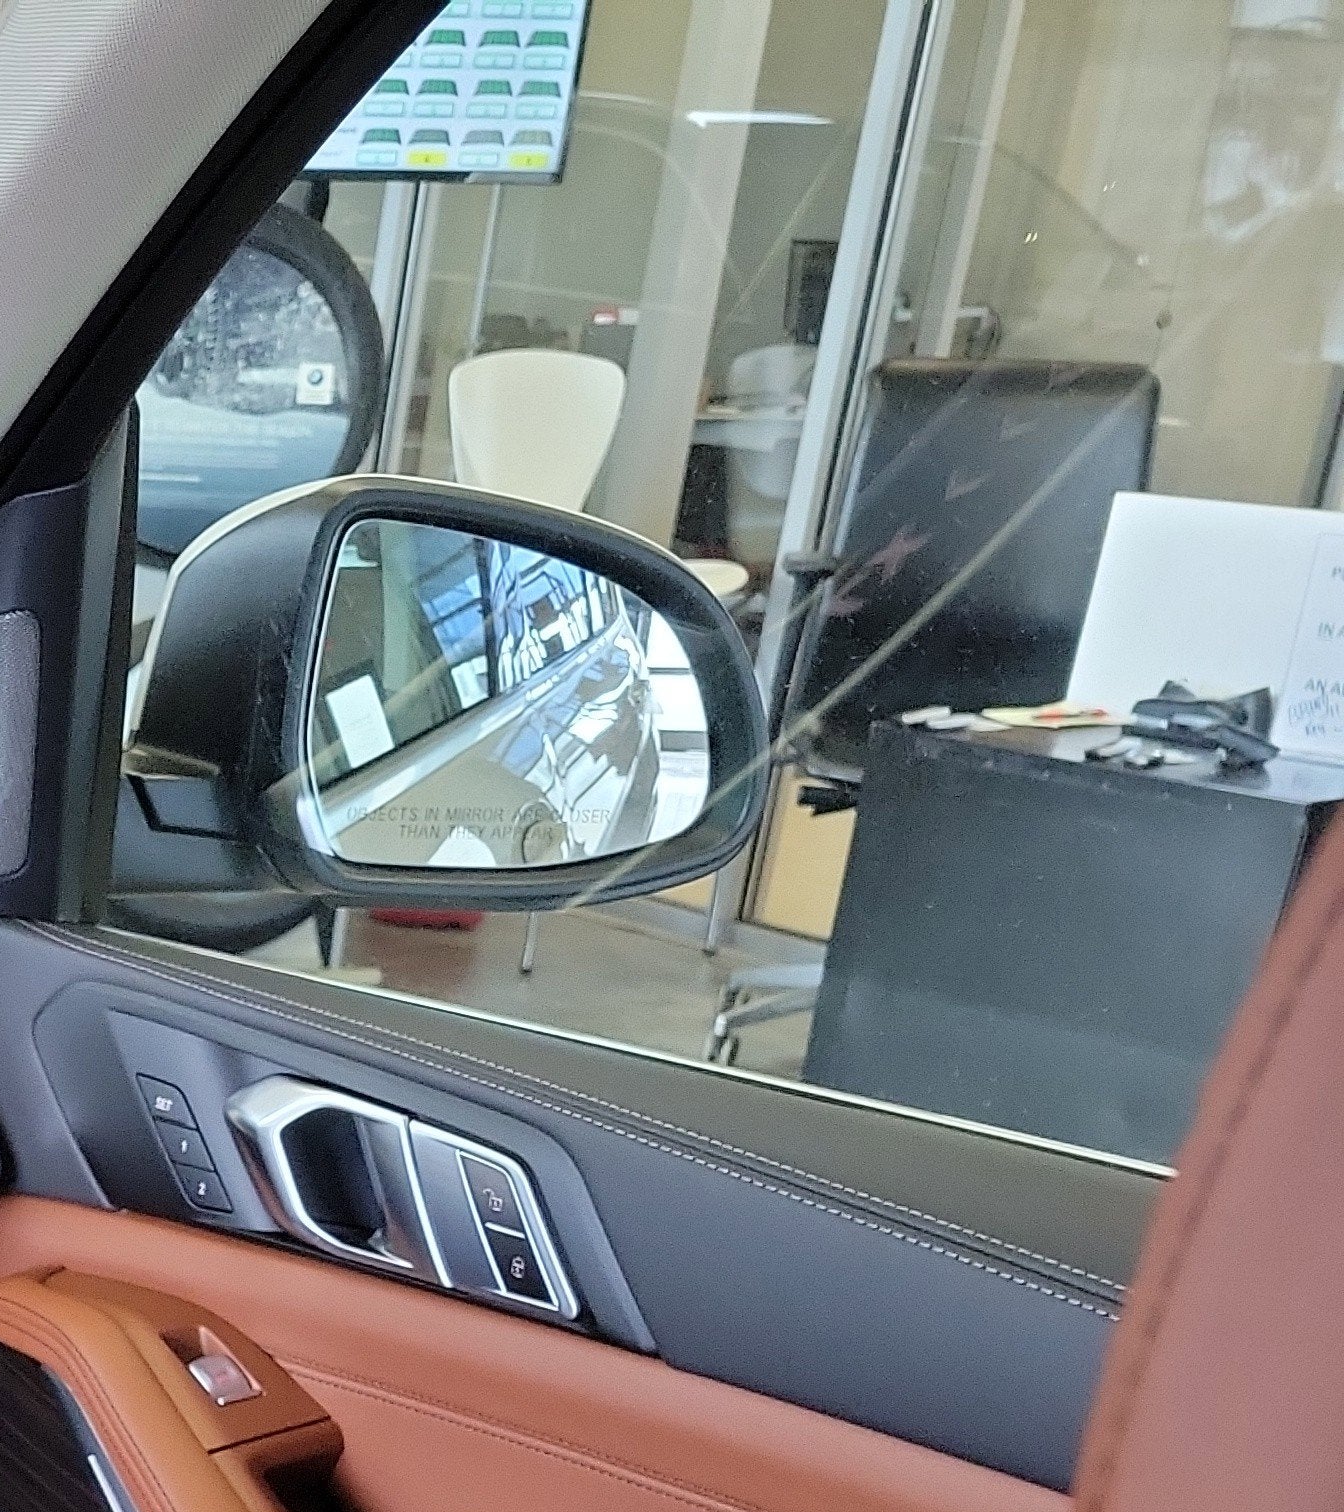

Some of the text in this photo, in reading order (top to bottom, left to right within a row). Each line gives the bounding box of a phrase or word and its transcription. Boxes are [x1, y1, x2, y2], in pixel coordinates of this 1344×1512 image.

[347, 806, 418, 822] OBJECTS
[424, 807, 439, 821] IN
[446, 806, 504, 822] MIRROR
[399, 824, 440, 839] THAN
